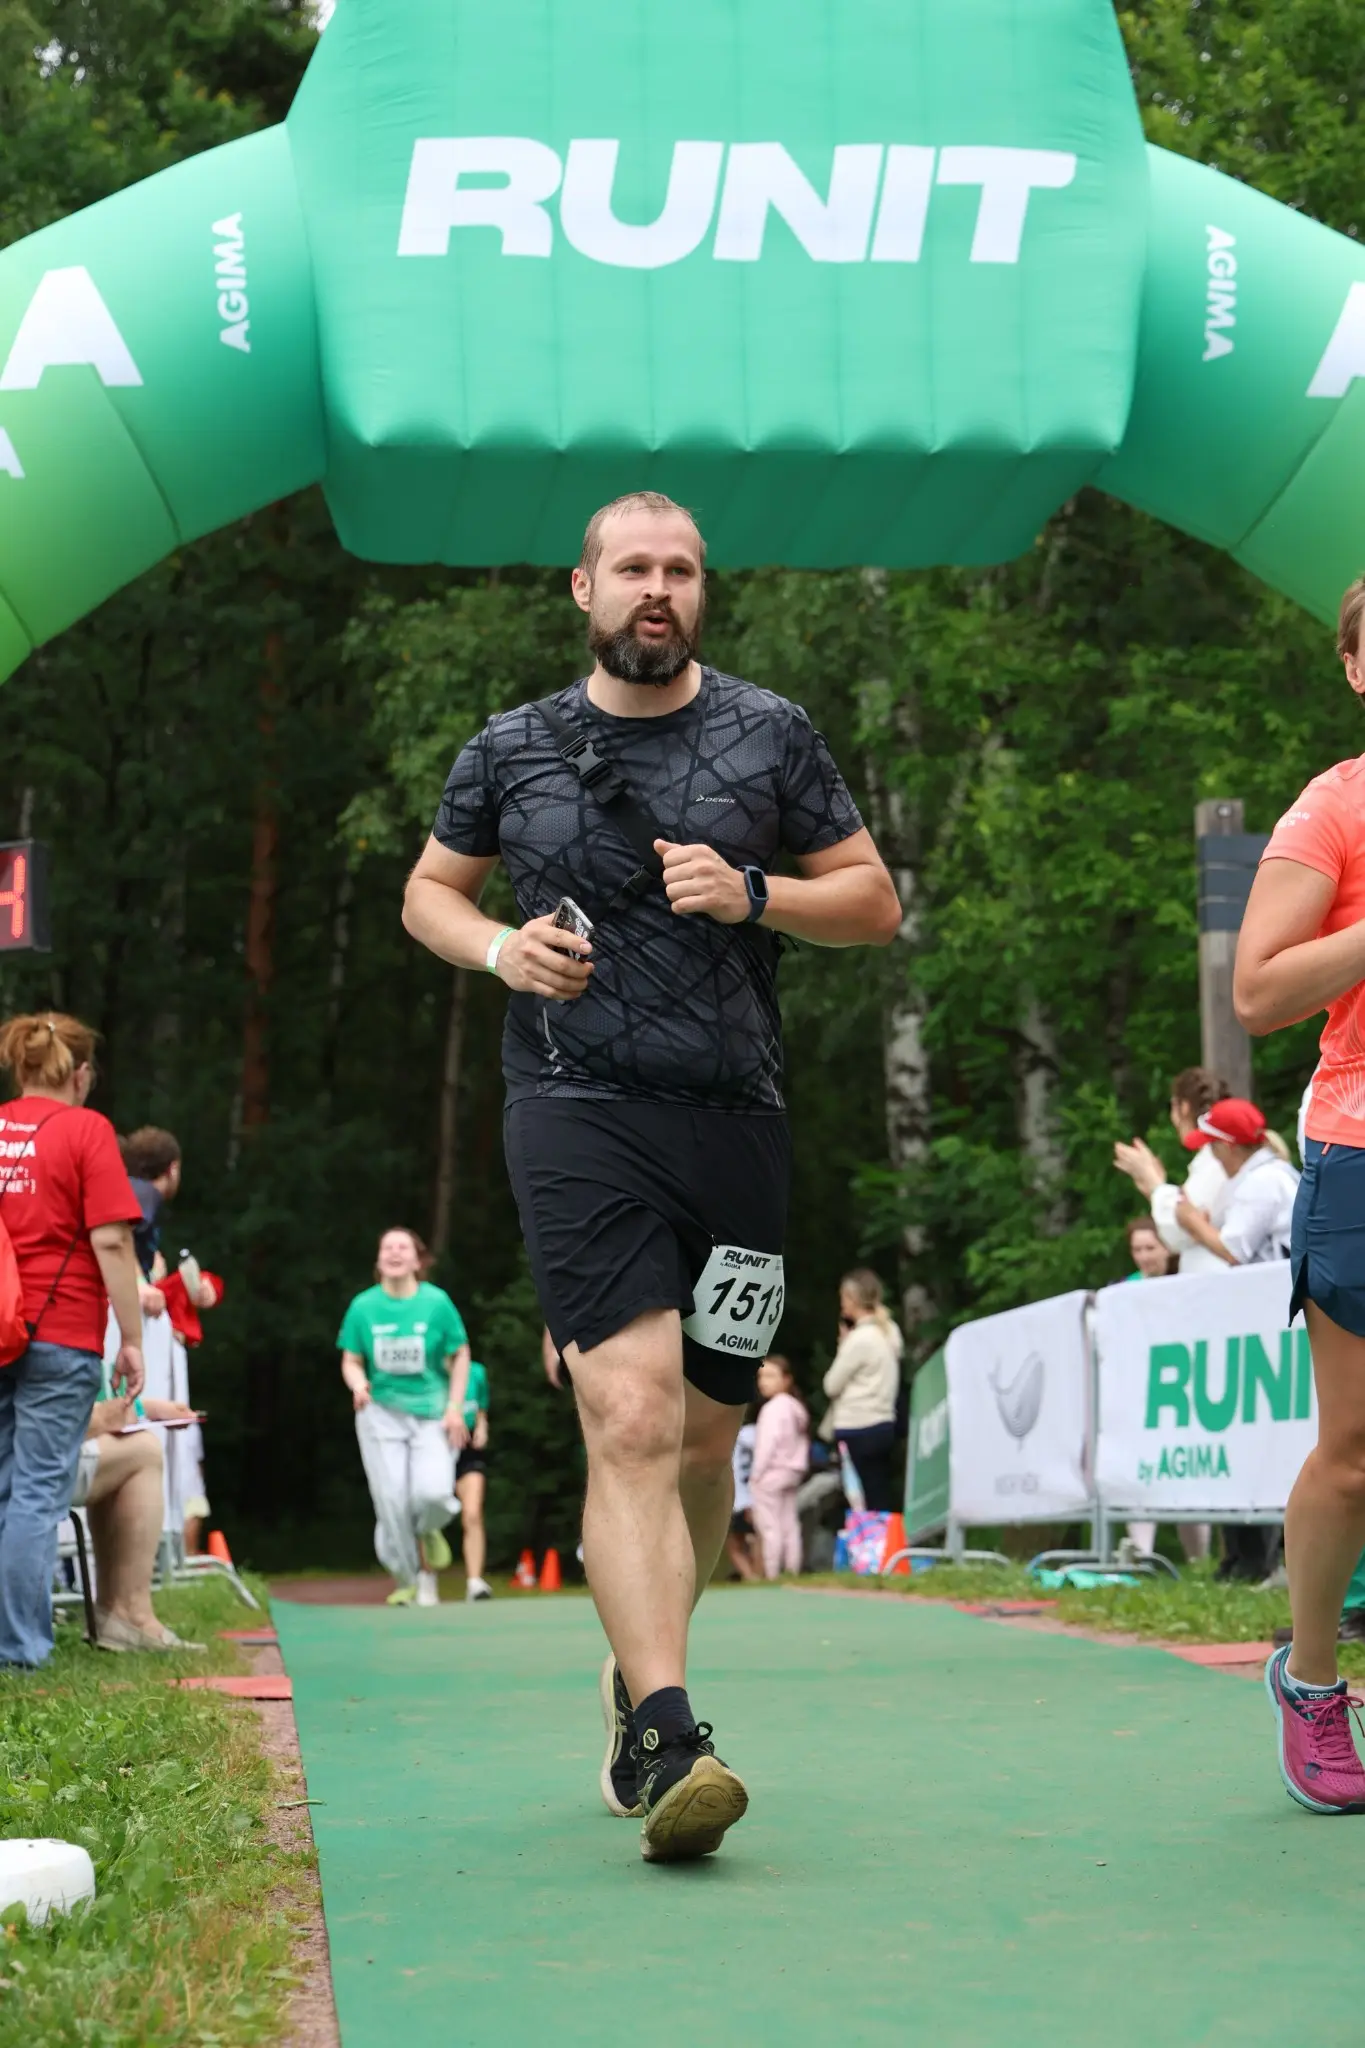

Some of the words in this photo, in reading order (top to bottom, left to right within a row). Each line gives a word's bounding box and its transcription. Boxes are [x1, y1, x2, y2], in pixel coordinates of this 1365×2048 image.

[396, 136, 1077, 270] RUNIT
[211, 212, 252, 354] AGIMA
[1201, 223, 1237, 363] AGIMA
[723, 1249, 771, 1269] RUNIT
[708, 1277, 783, 1326] 1513
[715, 1332, 759, 1353] AGIMA
[1144, 1326, 1312, 1433] RUNI
[1137, 1460, 1154, 1486] by
[1156, 1444, 1231, 1480] AGIMA
